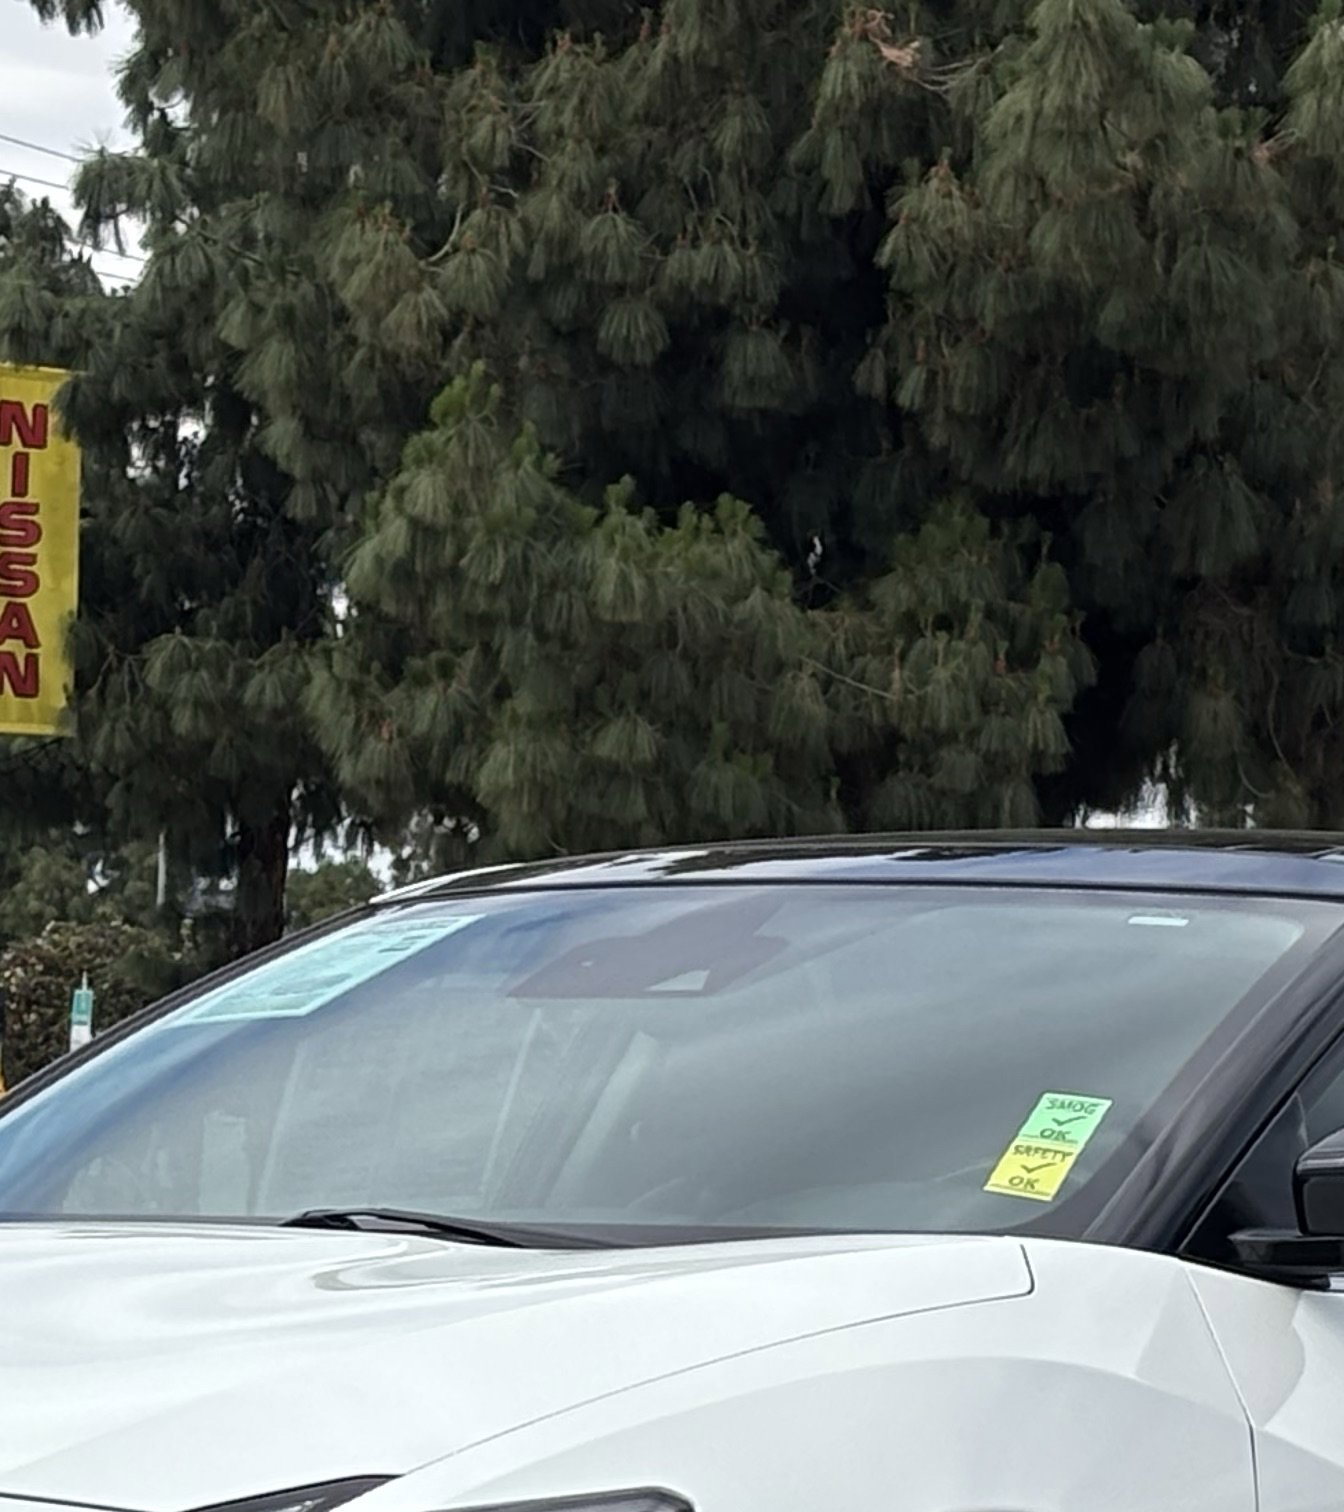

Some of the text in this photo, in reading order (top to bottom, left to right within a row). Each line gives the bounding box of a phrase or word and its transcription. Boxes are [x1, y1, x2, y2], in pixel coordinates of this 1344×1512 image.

[1045, 1098, 1102, 1115] SMOG
[1040, 1128, 1072, 1141] OK
[1013, 1145, 1073, 1162] SAFETY
[1008, 1176, 1039, 1190] OK
